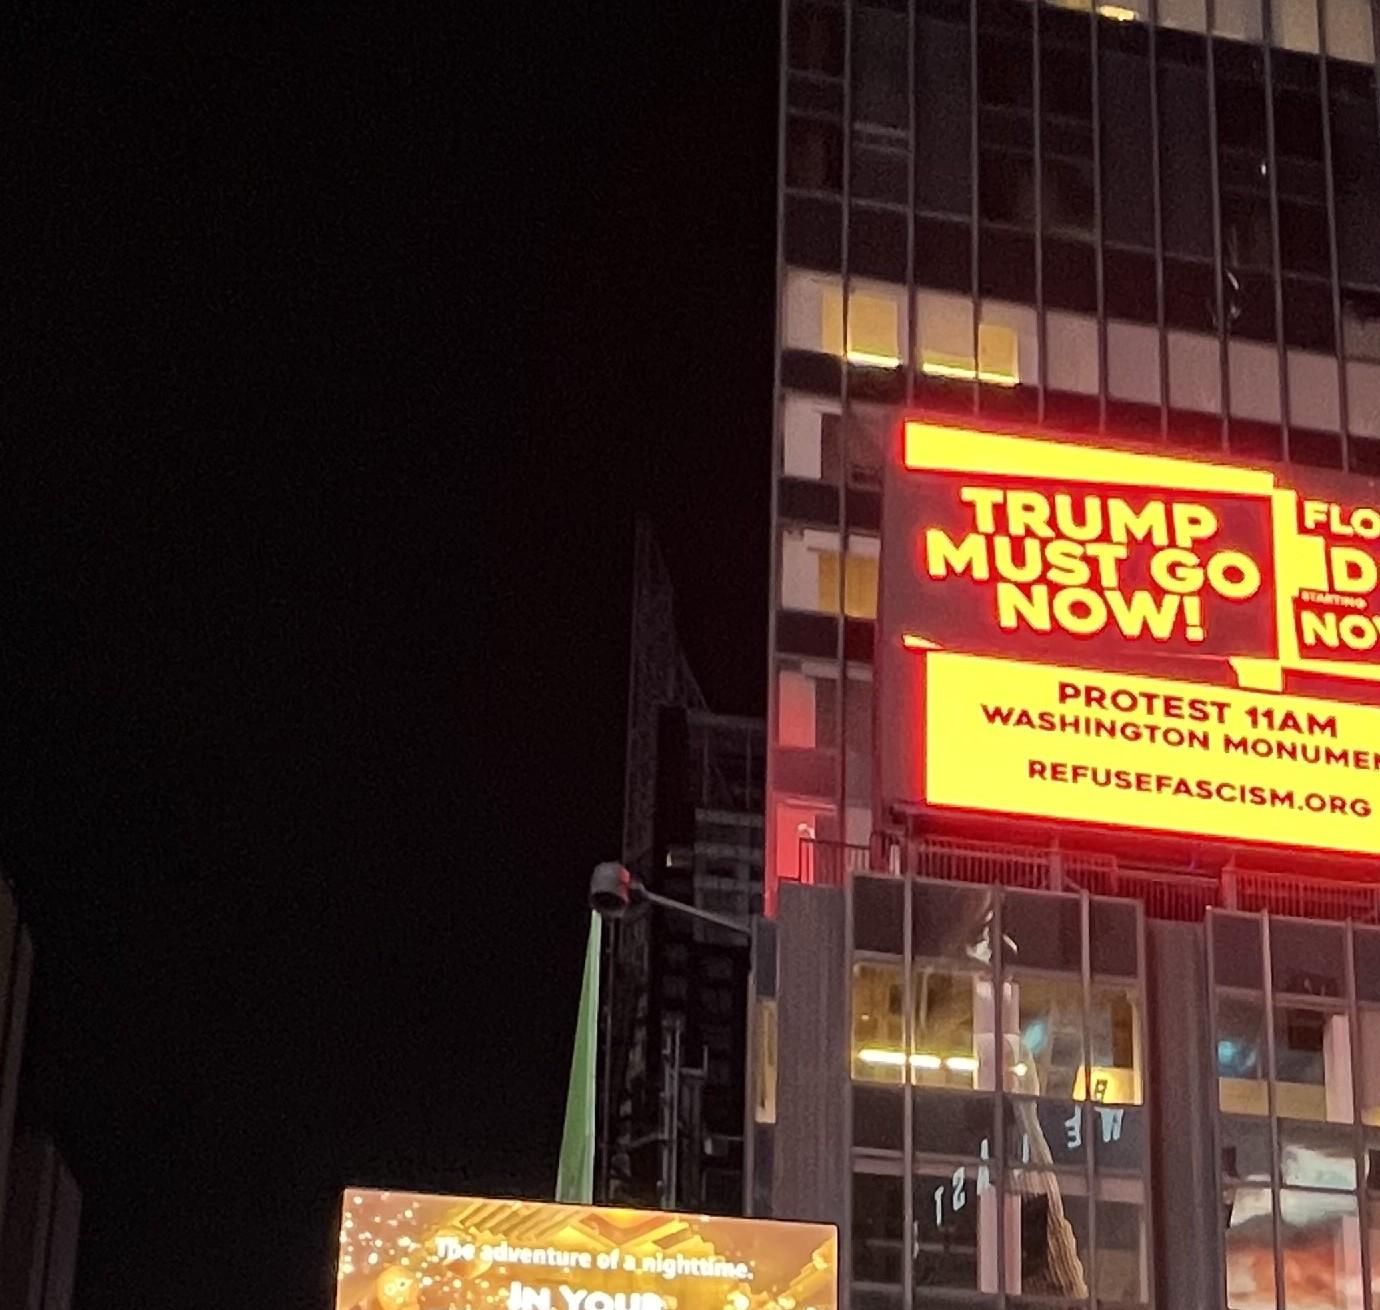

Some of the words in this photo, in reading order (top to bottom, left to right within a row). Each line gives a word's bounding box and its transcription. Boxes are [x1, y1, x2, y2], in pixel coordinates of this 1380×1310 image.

[961, 487, 1219, 549] TRUMP
[926, 529, 1128, 588] MUST
[1150, 547, 1260, 599] GO
[997, 583, 1206, 642] NOW!
[981, 703, 1210, 752] WASHINGTON
[1058, 682, 1231, 724] PROTEST
[1244, 706, 1338, 738] 11AM
[1027, 759, 1372, 818] REFUSEFASCISM.ORG
[480, 1242, 591, 1269] adventure
[597, 1248, 618, 1268] of
[624, 1253, 636, 1269] a
[641, 1250, 754, 1280] nighttime.
